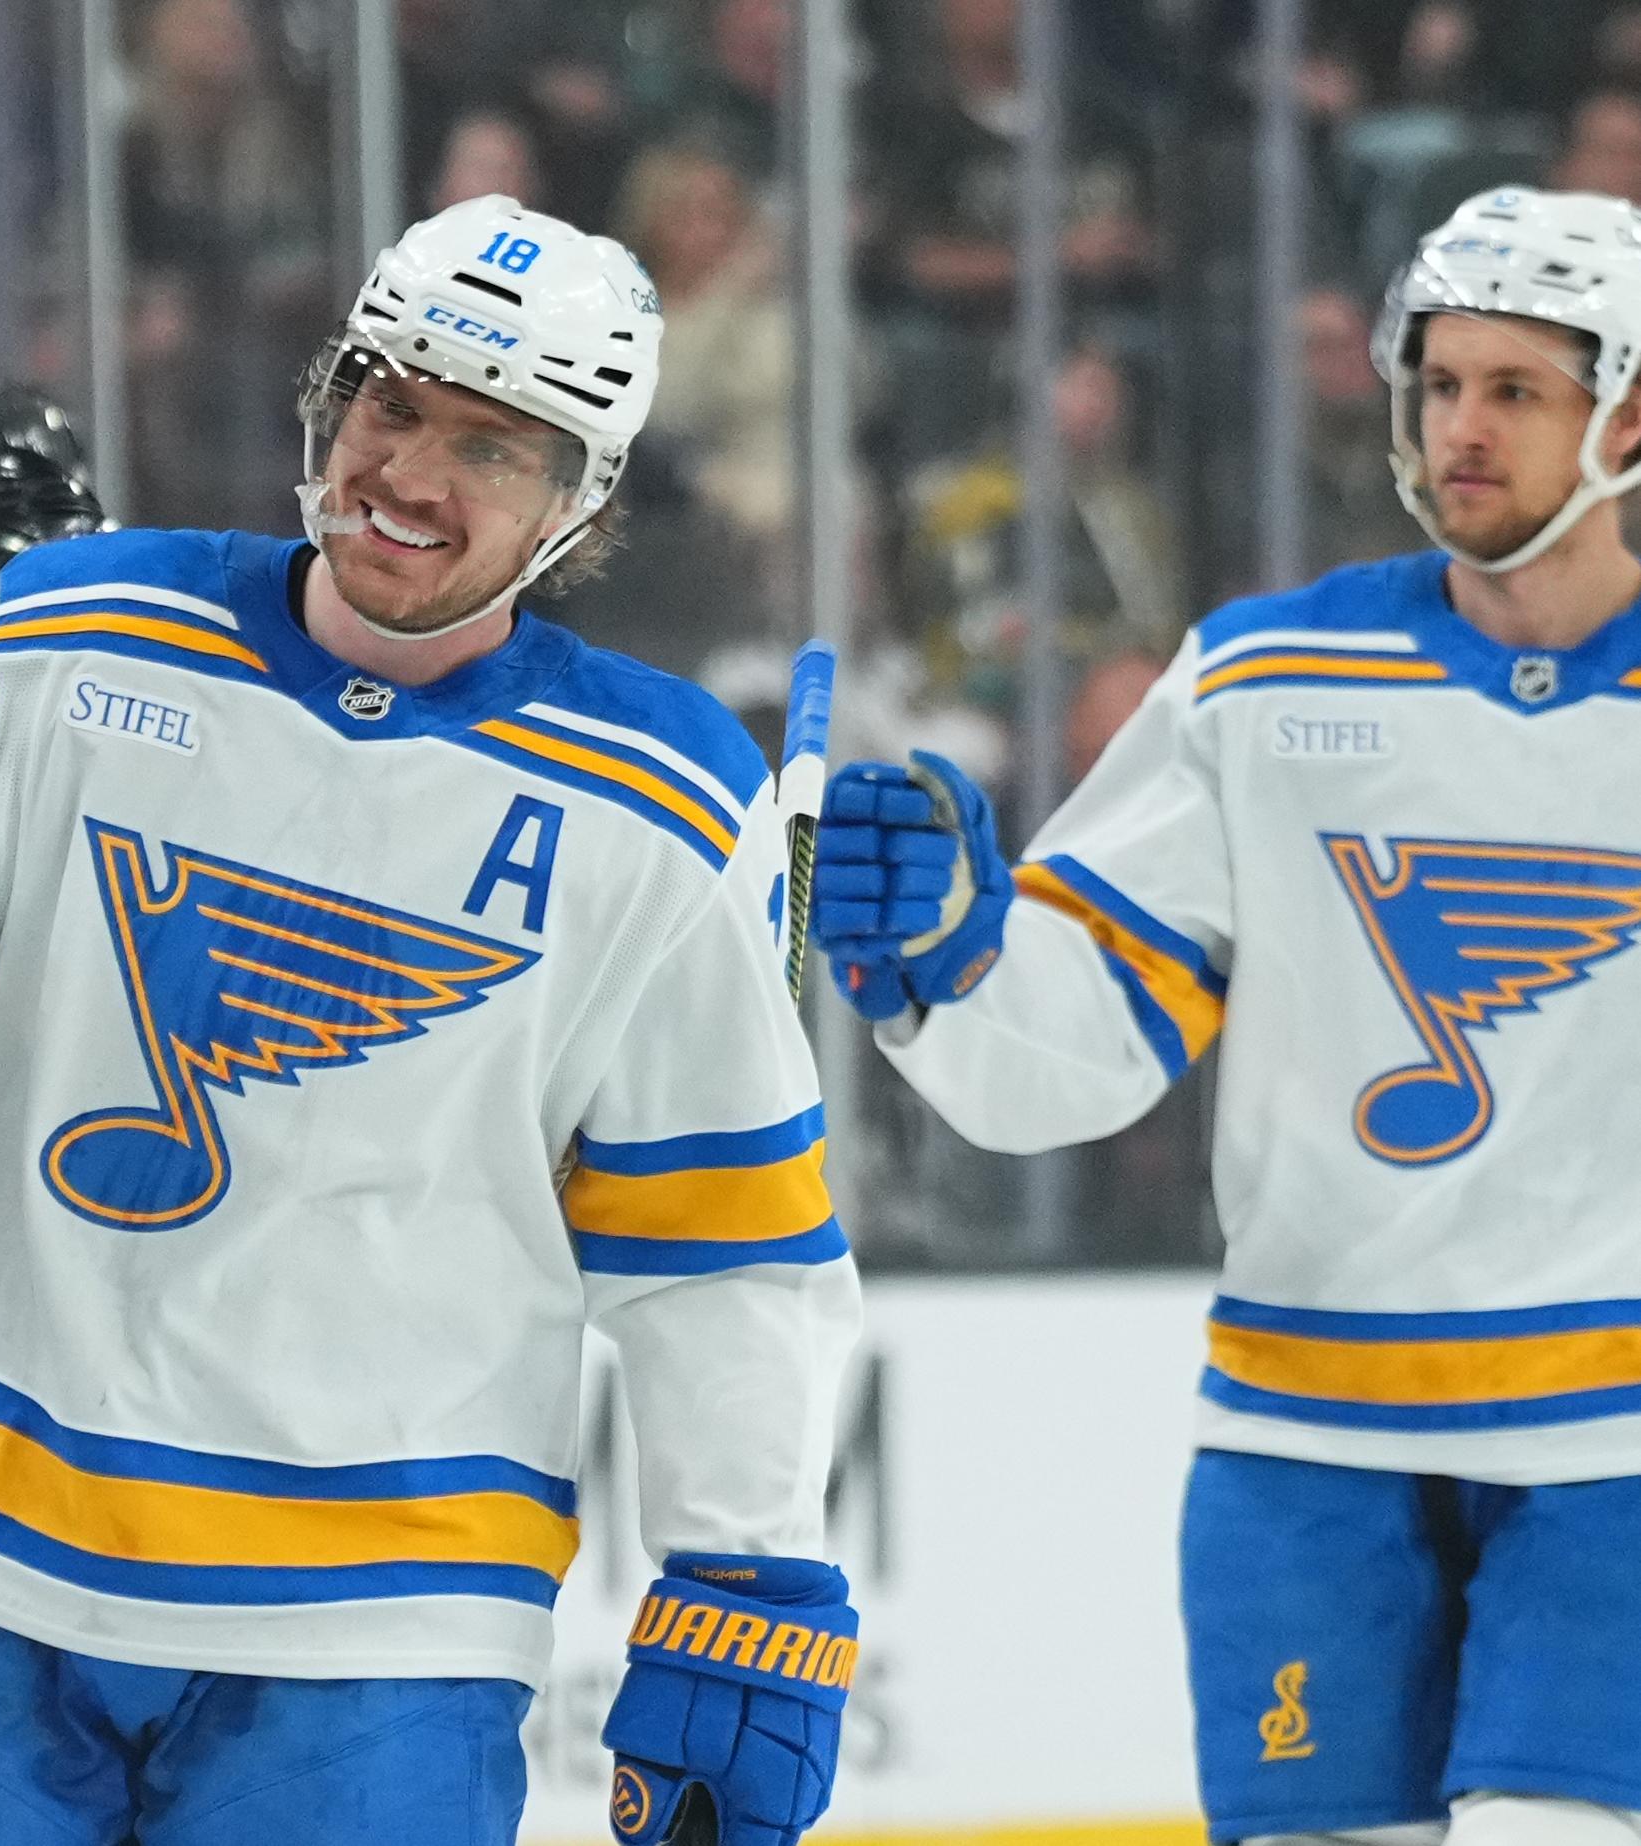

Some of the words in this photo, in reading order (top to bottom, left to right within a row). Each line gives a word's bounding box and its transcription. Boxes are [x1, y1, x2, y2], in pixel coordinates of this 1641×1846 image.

[477, 231, 541, 275] 18
[423, 304, 519, 350] CCM
[69, 681, 195, 750] STIFEL
[348, 694, 383, 709] NHL
[1275, 714, 1390, 754] STIFEL
[461, 792, 565, 935] A
[691, 1567, 758, 1581] THOMAS
